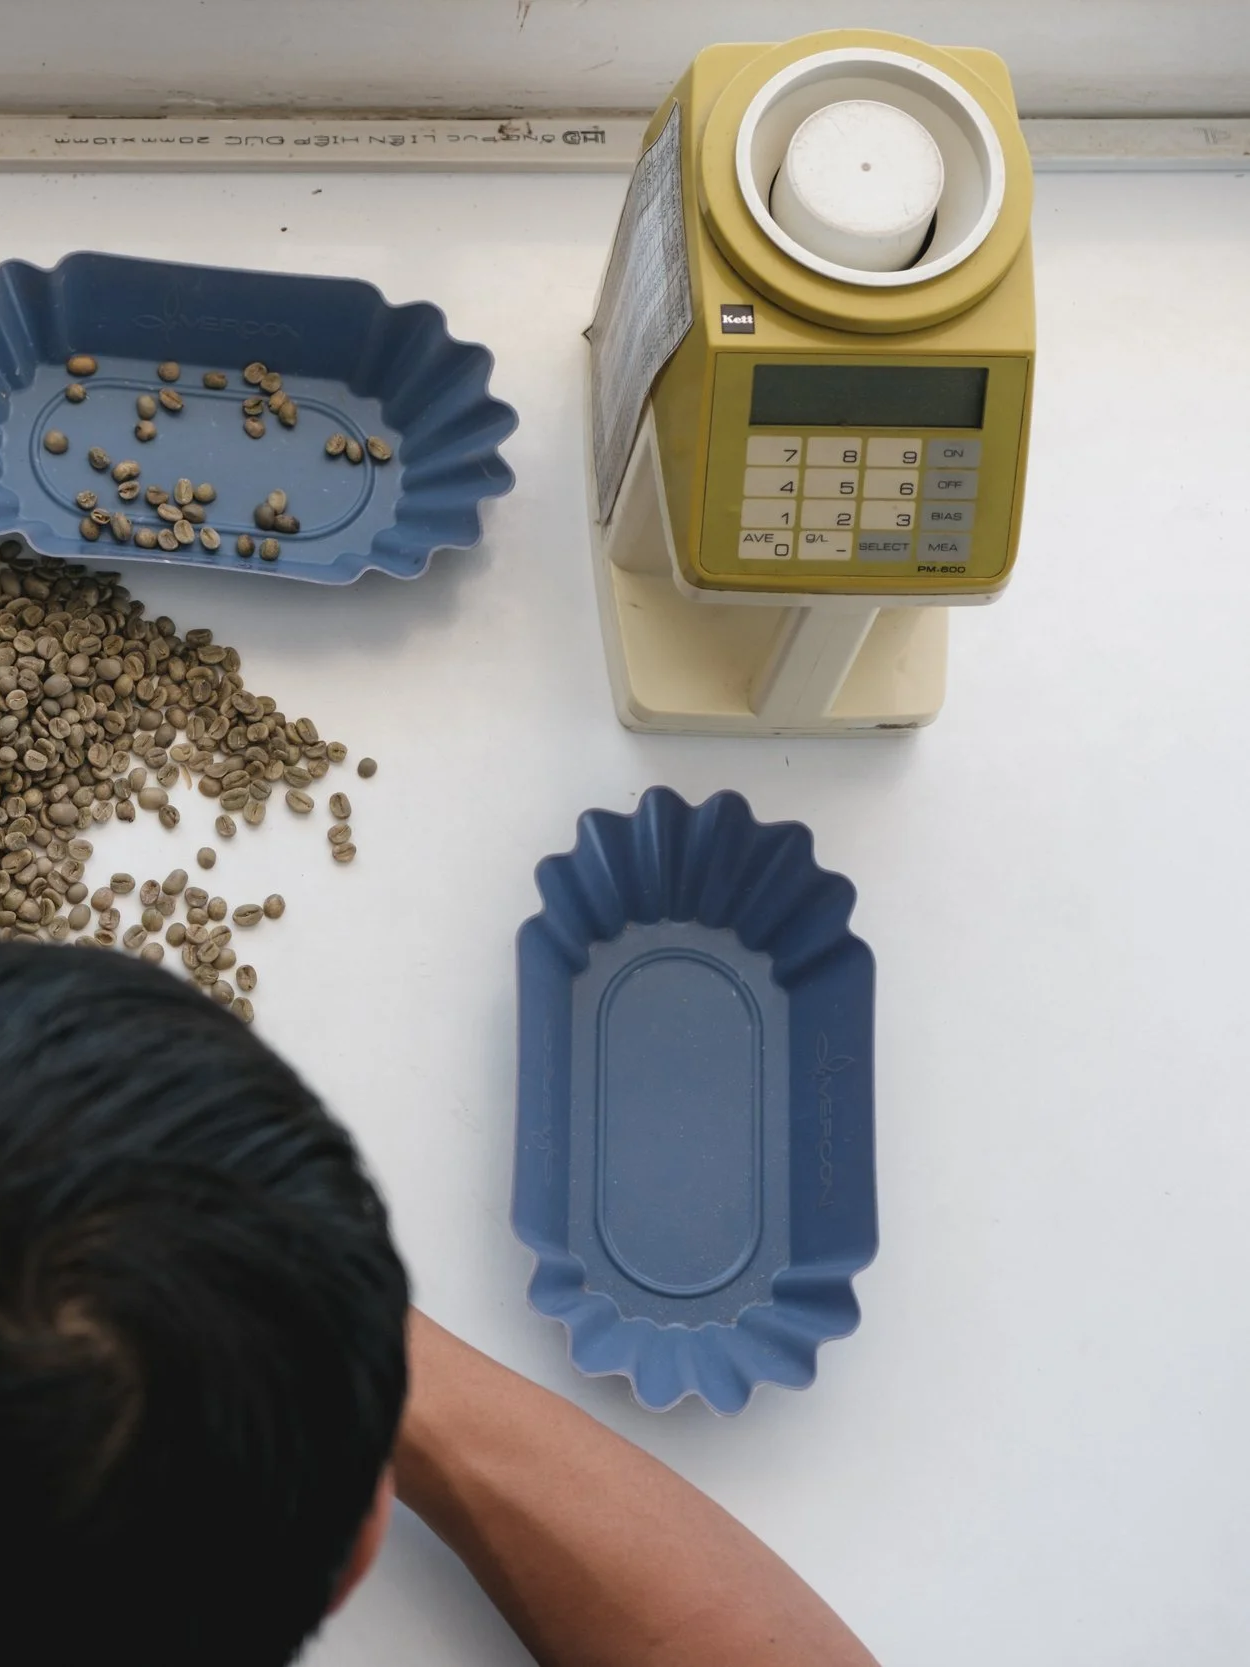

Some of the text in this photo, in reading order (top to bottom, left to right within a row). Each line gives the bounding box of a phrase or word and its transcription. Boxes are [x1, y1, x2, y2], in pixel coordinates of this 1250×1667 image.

[722, 313, 754, 325] Kett
[784, 449, 917, 464] 7 8 9
[943, 449, 964, 458] ON
[780, 481, 914, 496] 4 5 6
[937, 481, 963, 490] OFF
[782, 512, 911, 527] 1 2 3
[931, 512, 962, 521] BIAS
[743, 534, 774, 544] AVE
[774, 544, 789, 557] 0
[859, 542, 909, 551] SELECT
[928, 542, 958, 552] MEA
